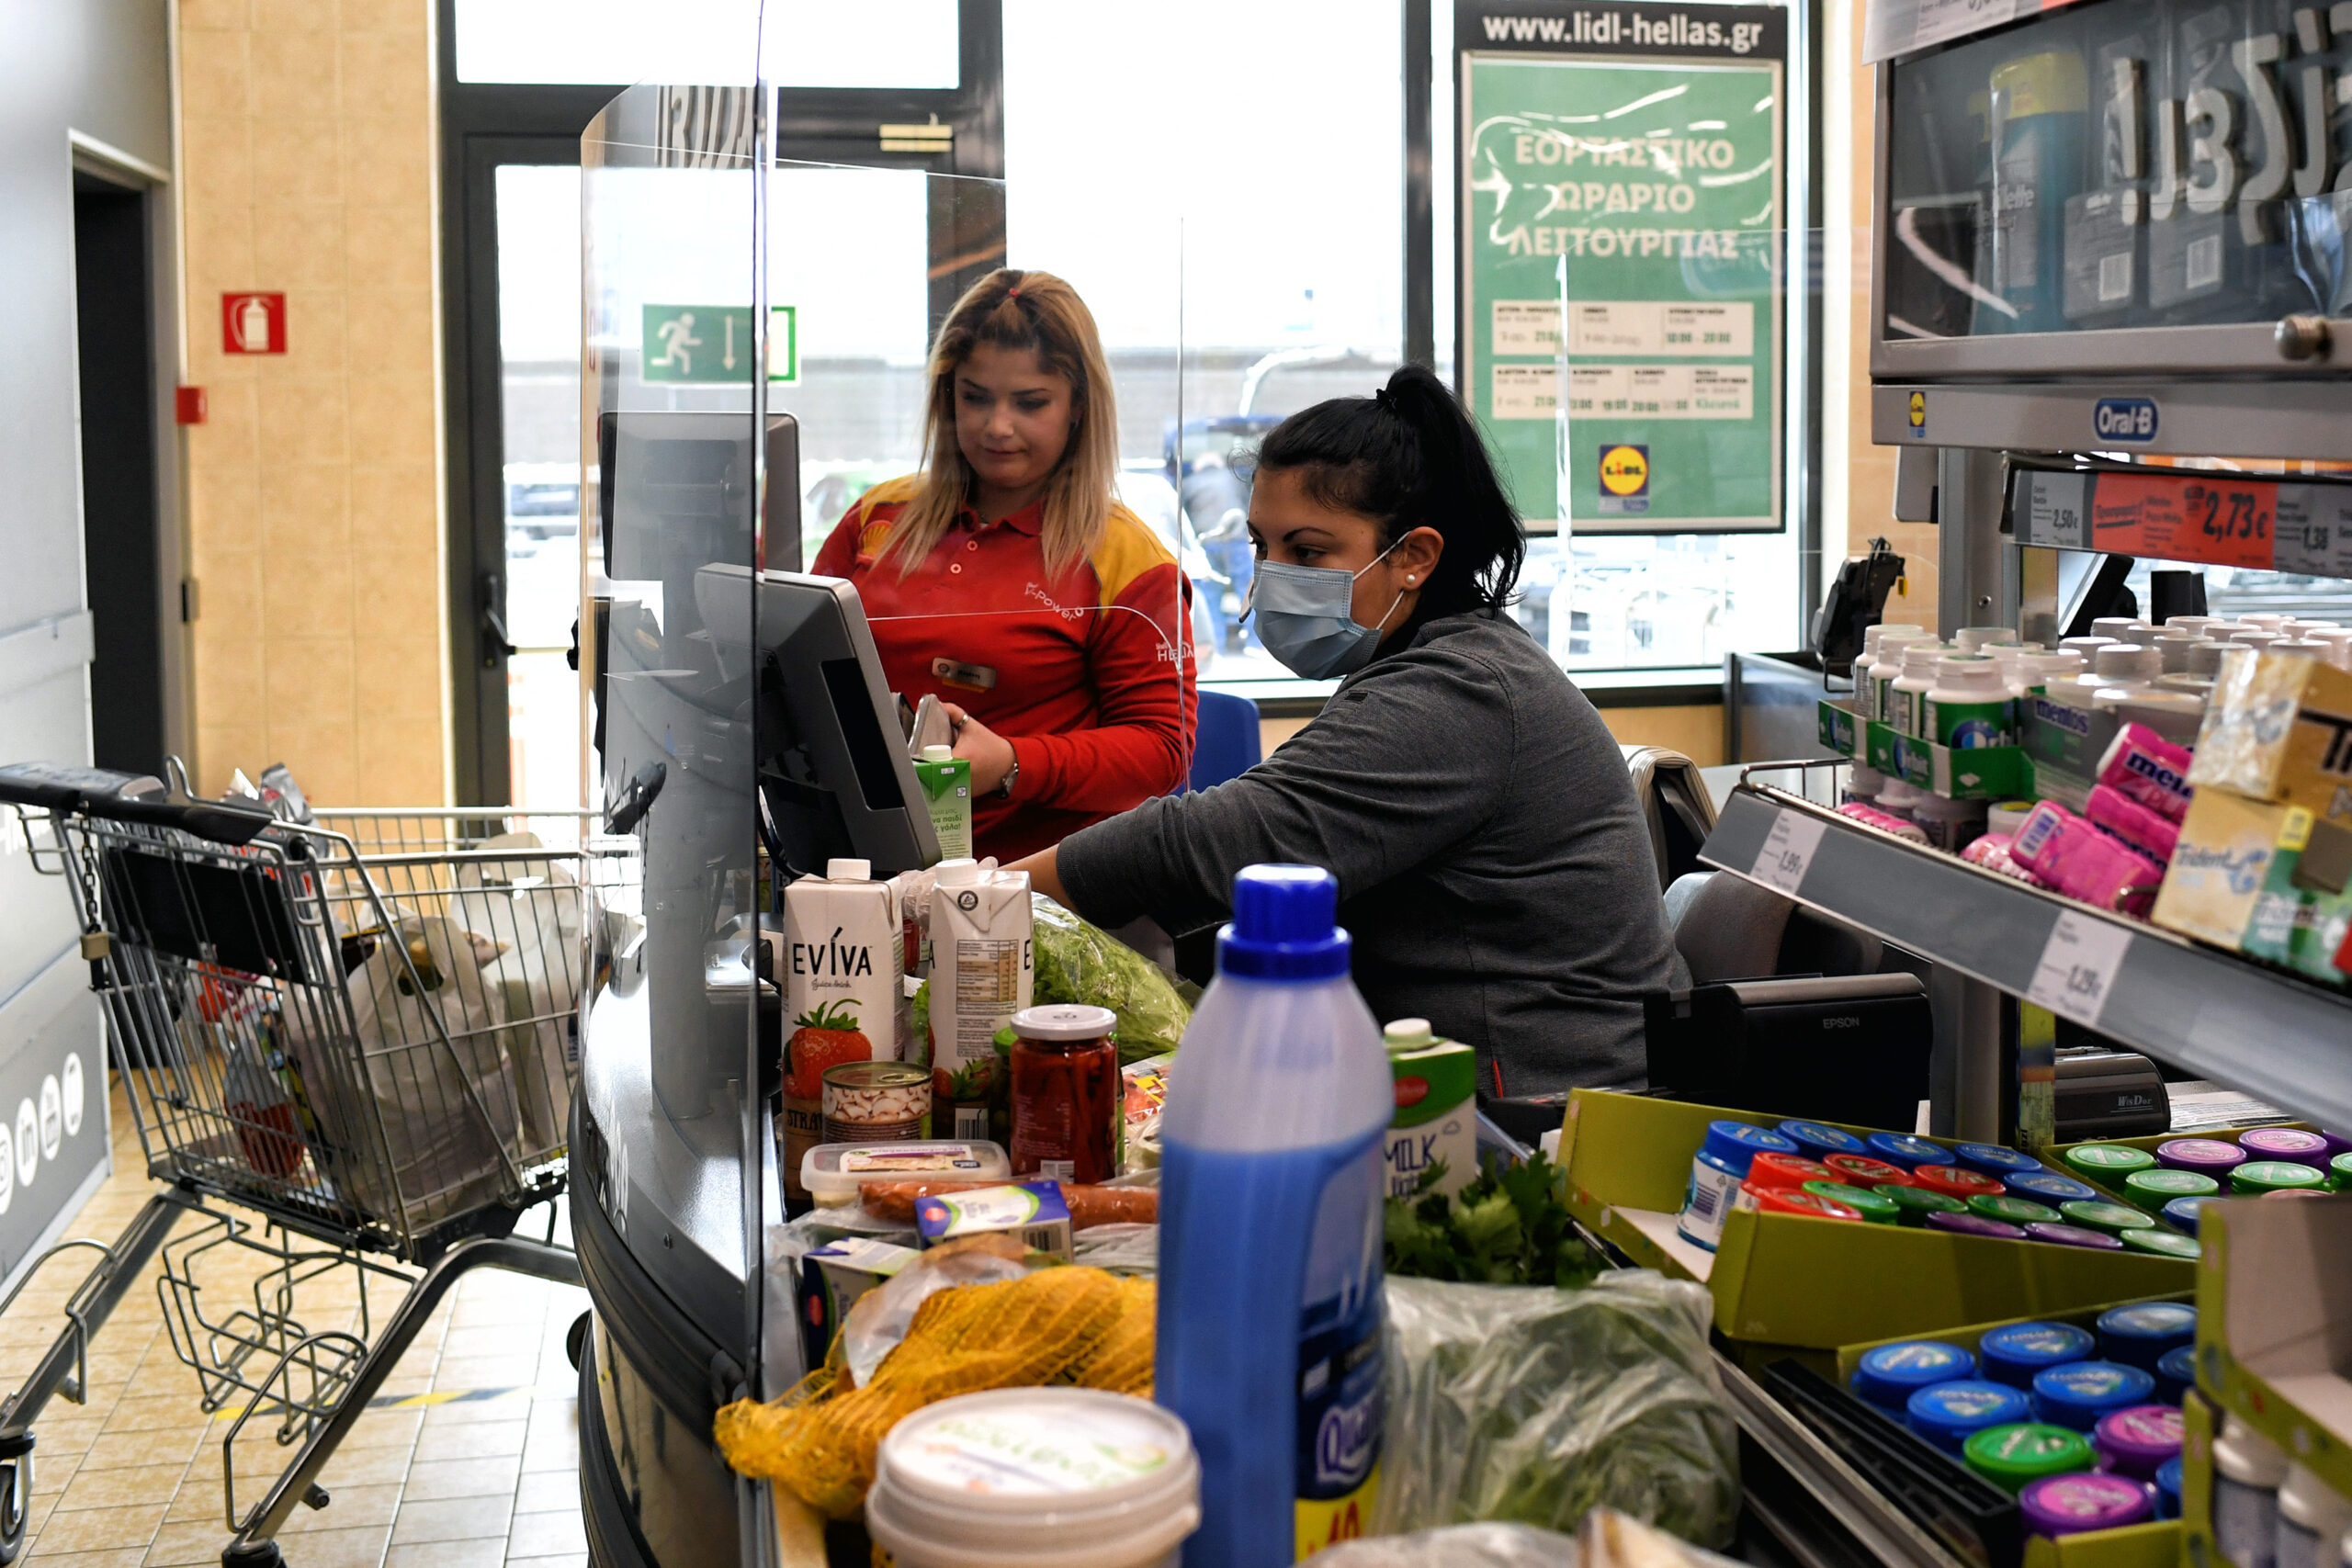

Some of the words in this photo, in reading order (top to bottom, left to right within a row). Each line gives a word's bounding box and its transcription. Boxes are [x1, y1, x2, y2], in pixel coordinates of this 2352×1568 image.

[1483, 12, 1763, 52] www.lidl-hellas.gr
[1555, 181, 1696, 213] ΩΡΑΡΙΟ
[1509, 225, 1740, 259] ΛΕΙΤΟΥΡΓΙΑΣ
[2098, 404, 2153, 434] Oral-B
[1823, 1017, 1860, 1029] EPSON
[1384, 1133, 1436, 1173] MILK
